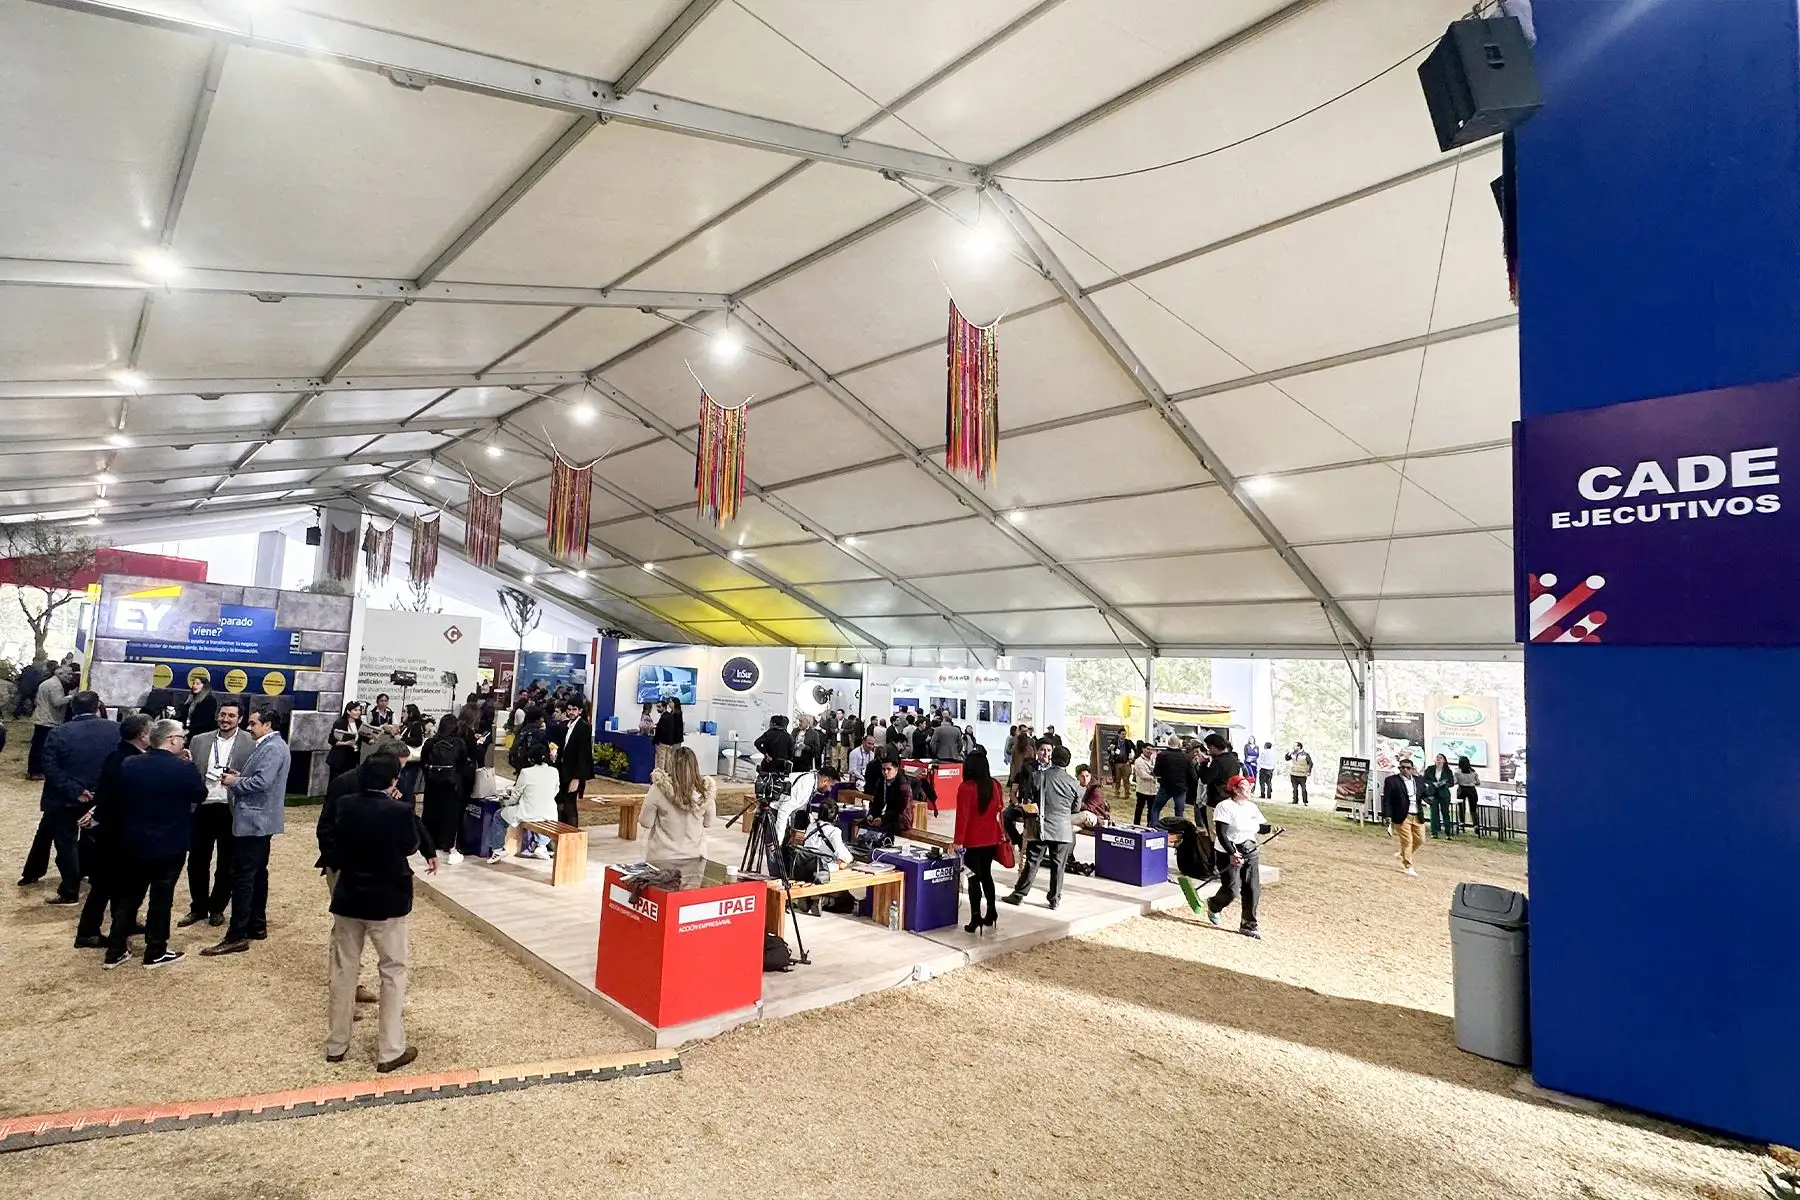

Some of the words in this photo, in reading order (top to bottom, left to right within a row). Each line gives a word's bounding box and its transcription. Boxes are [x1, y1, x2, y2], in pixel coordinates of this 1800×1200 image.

[1578, 447, 1780, 501] CADE
[1552, 494, 1781, 529] EJECUTIVOS
[114, 600, 172, 632] EY
[192, 626, 223, 636] viene?
[736, 669, 752, 679] InSur
[1114, 836, 1133, 845] CADE
[935, 867, 953, 877] CADE
[718, 897, 755, 915] IPAE
[678, 923, 699, 933] ACCIÓN
[699, 918, 732, 929] EMPRESARIAL
